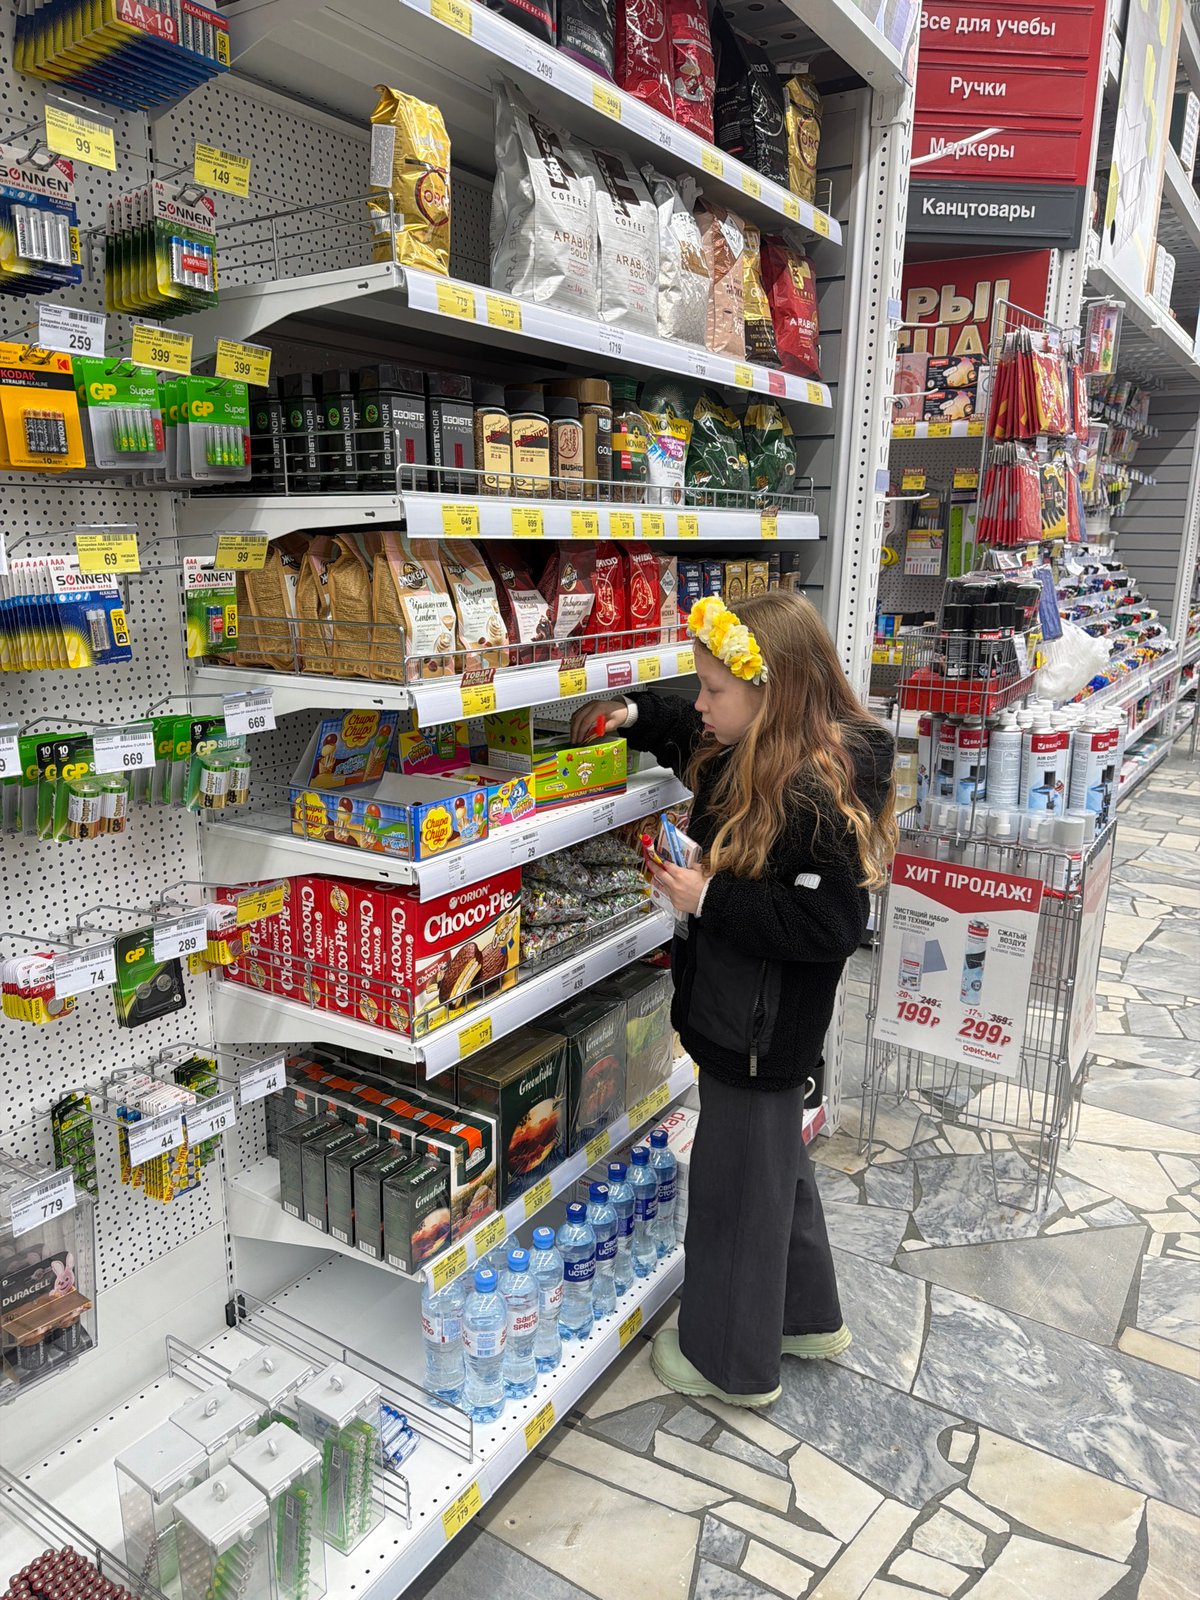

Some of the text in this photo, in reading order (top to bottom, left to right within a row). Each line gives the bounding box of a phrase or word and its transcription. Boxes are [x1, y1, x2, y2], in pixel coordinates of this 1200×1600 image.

[920, 11, 1056, 37] Все для учебы
[536, 59, 553, 79] 2499
[949, 76, 1007, 99] Ручки
[76, 137, 91, 154] 99
[929, 136, 1015, 162] Маркеры
[56, 160, 70, 174] ХИТ
[213, 168, 230, 185] 149
[154, 182, 165, 191] AA
[551, 190, 588, 209] COFFEE
[158, 199, 213, 227] SONNEN
[922, 197, 1036, 222] Канцтовары
[615, 216, 646, 234] COFFEE
[570, 247, 588, 261] SOLO
[455, 295, 470, 307] 779
[69, 334, 92, 351] 259
[609, 341, 622, 354] 1719
[151, 348, 170, 363] 399
[0, 369, 36, 381] KODAK
[233, 361, 251, 375] 399
[2, 378, 27, 386] XTRALIFE
[89, 382, 117, 401] GP
[129, 383, 156, 397] Super
[191, 400, 214, 417] GP
[224, 402, 246, 414] Super
[392, 408, 426, 421] EGOISTE
[408, 420, 425, 430] NOIR
[442, 414, 473, 427] EGOISTE
[457, 426, 473, 434] NOIR
[514, 427, 548, 449] BUSHIDO
[461, 516, 472, 526] 649
[527, 519, 538, 528] 899
[50, 558, 65, 566] AAA
[104, 552, 117, 566] 69
[237, 552, 250, 563] 99
[56, 575, 113, 588] SONNEN
[188, 571, 233, 584] SONNEN
[113, 616, 125, 627] 10
[227, 612, 237, 621] 10
[480, 696, 492, 706] 349
[248, 715, 266, 730] 669
[347, 713, 377, 727] Chupa
[194, 724, 203, 734] 10
[344, 724, 373, 741] Chups
[39, 745, 51, 756] 10
[58, 745, 69, 755] 10
[195, 737, 241, 756] GP Super
[123, 752, 143, 766] 669
[62, 762, 89, 781] GP
[425, 815, 449, 830] Chupa
[424, 826, 449, 845] Chups
[527, 846, 536, 858] 29
[904, 864, 1033, 906] ХИТ ПРОДАЖ!
[256, 902, 268, 913] 79
[893, 913, 935, 928] ДЛЯ ТЕХНИКИ
[894, 906, 950, 924] ЧИСТЯЩИЙ НАБОР
[997, 928, 1028, 941] СЖАТЫЙ
[178, 937, 197, 952] 289
[999, 936, 1027, 948] ВОЗДУХ
[125, 946, 146, 963] GP
[90, 969, 105, 985] 74
[920, 995, 936, 1008] 249
[896, 1001, 931, 1026] 199
[990, 1012, 1009, 1025] 359
[478, 1029, 491, 1042] 179
[585, 1023, 614, 1053] Greenfield
[959, 1018, 1002, 1045] 299
[962, 1044, 1003, 1060] ОФИСМАГ
[266, 1076, 278, 1090] 44
[518, 1061, 554, 1097] Greenfield
[209, 1117, 227, 1132] 119
[161, 1134, 174, 1148] 44
[414, 1177, 448, 1210] Greenfield
[41, 1198, 64, 1218] 779
[445, 1266, 457, 1280] 159
[2, 1278, 51, 1307] DURACELL
[456, 1506, 469, 1523] 179
